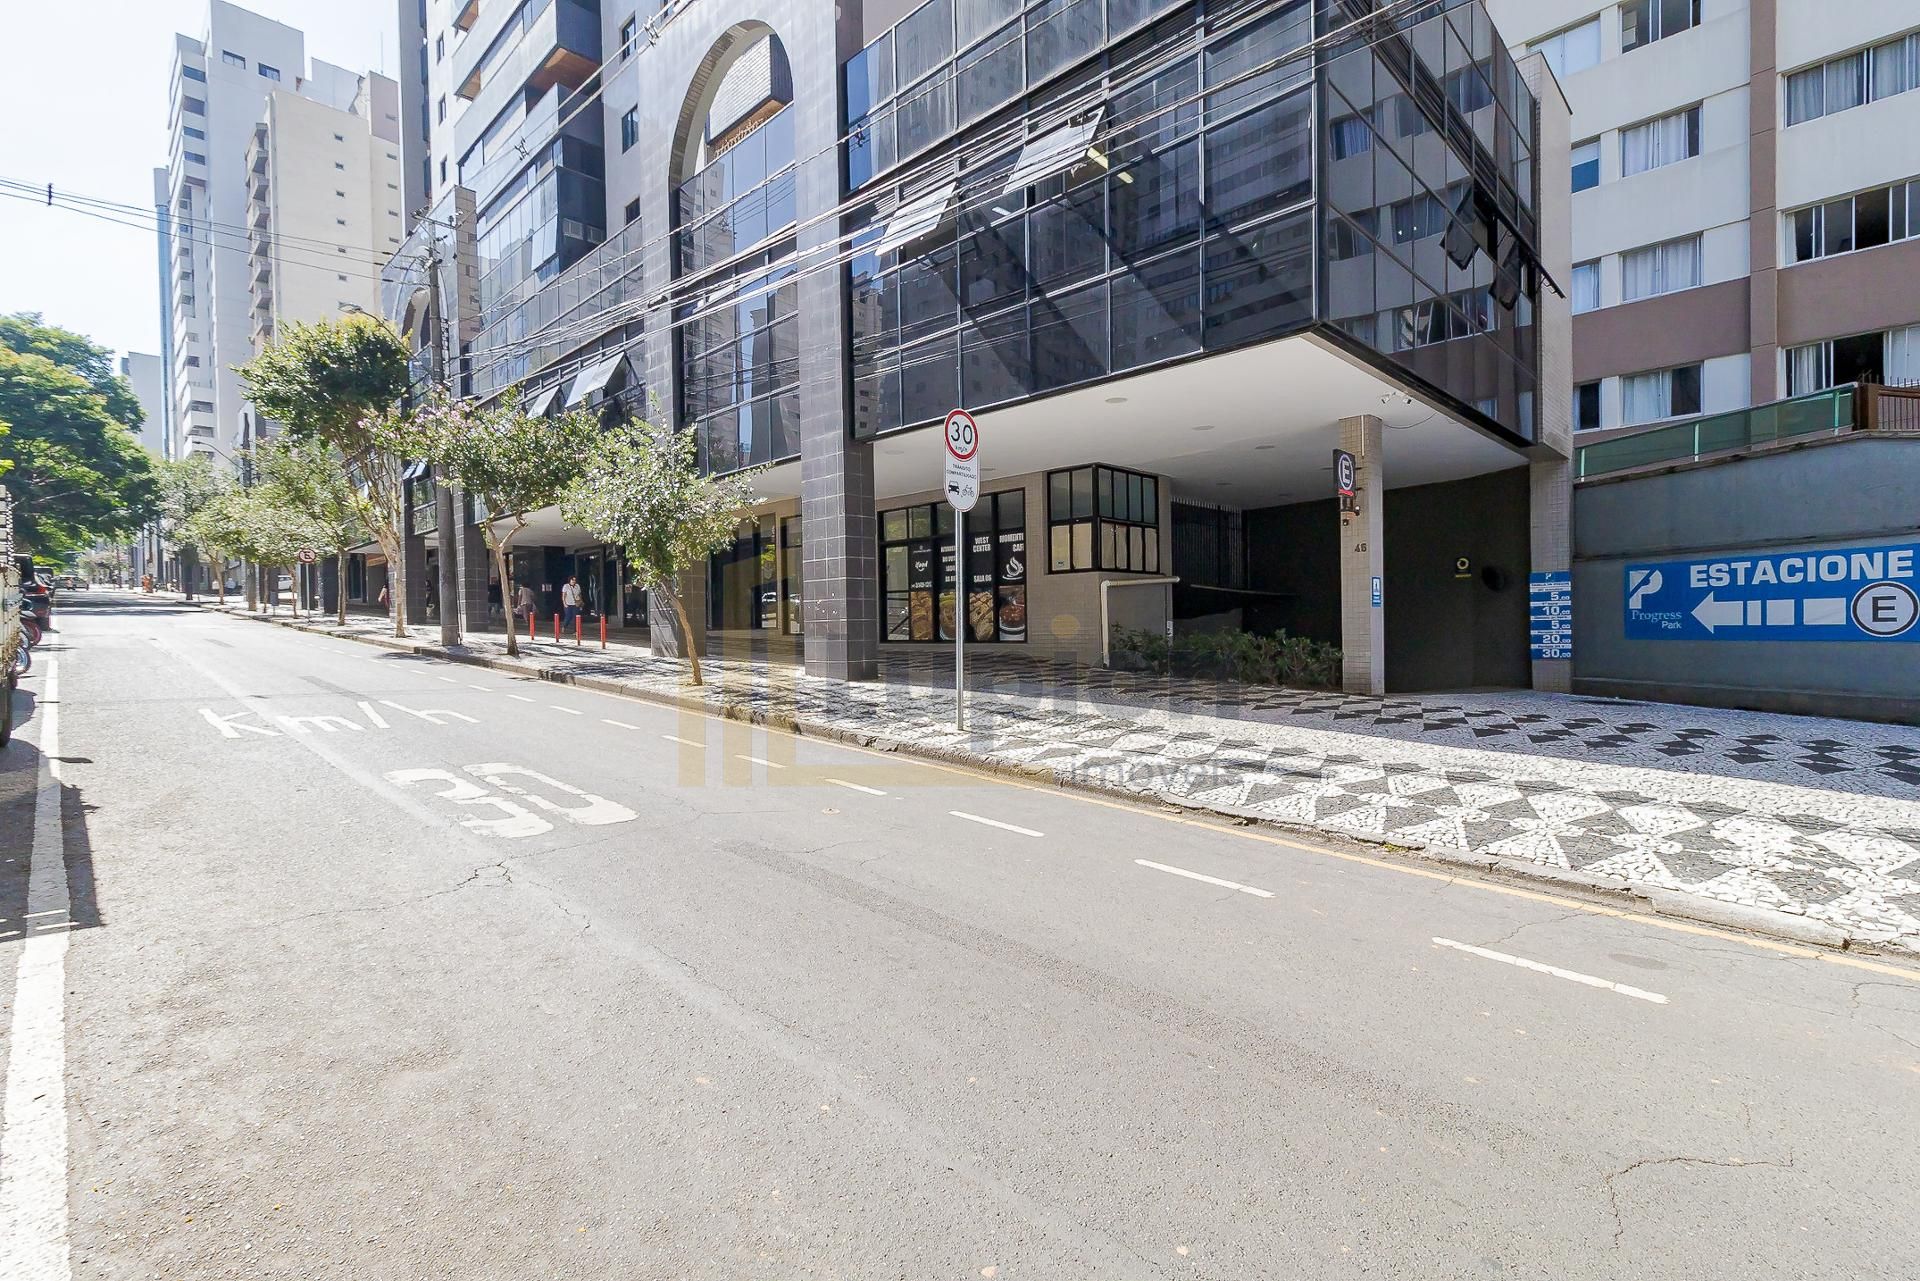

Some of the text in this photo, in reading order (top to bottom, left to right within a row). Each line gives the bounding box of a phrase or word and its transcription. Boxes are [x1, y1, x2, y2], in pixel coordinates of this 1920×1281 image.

[951, 421, 973, 445] 30
[1342, 459, 1351, 484] E
[973, 544, 991, 552] CENTER
[1689, 549, 1914, 588] ESTACIONE
[1631, 609, 1682, 623] Progress
[1871, 595, 1898, 623] E
[1661, 620, 1682, 629] Park
[384, 762, 640, 839] 30
